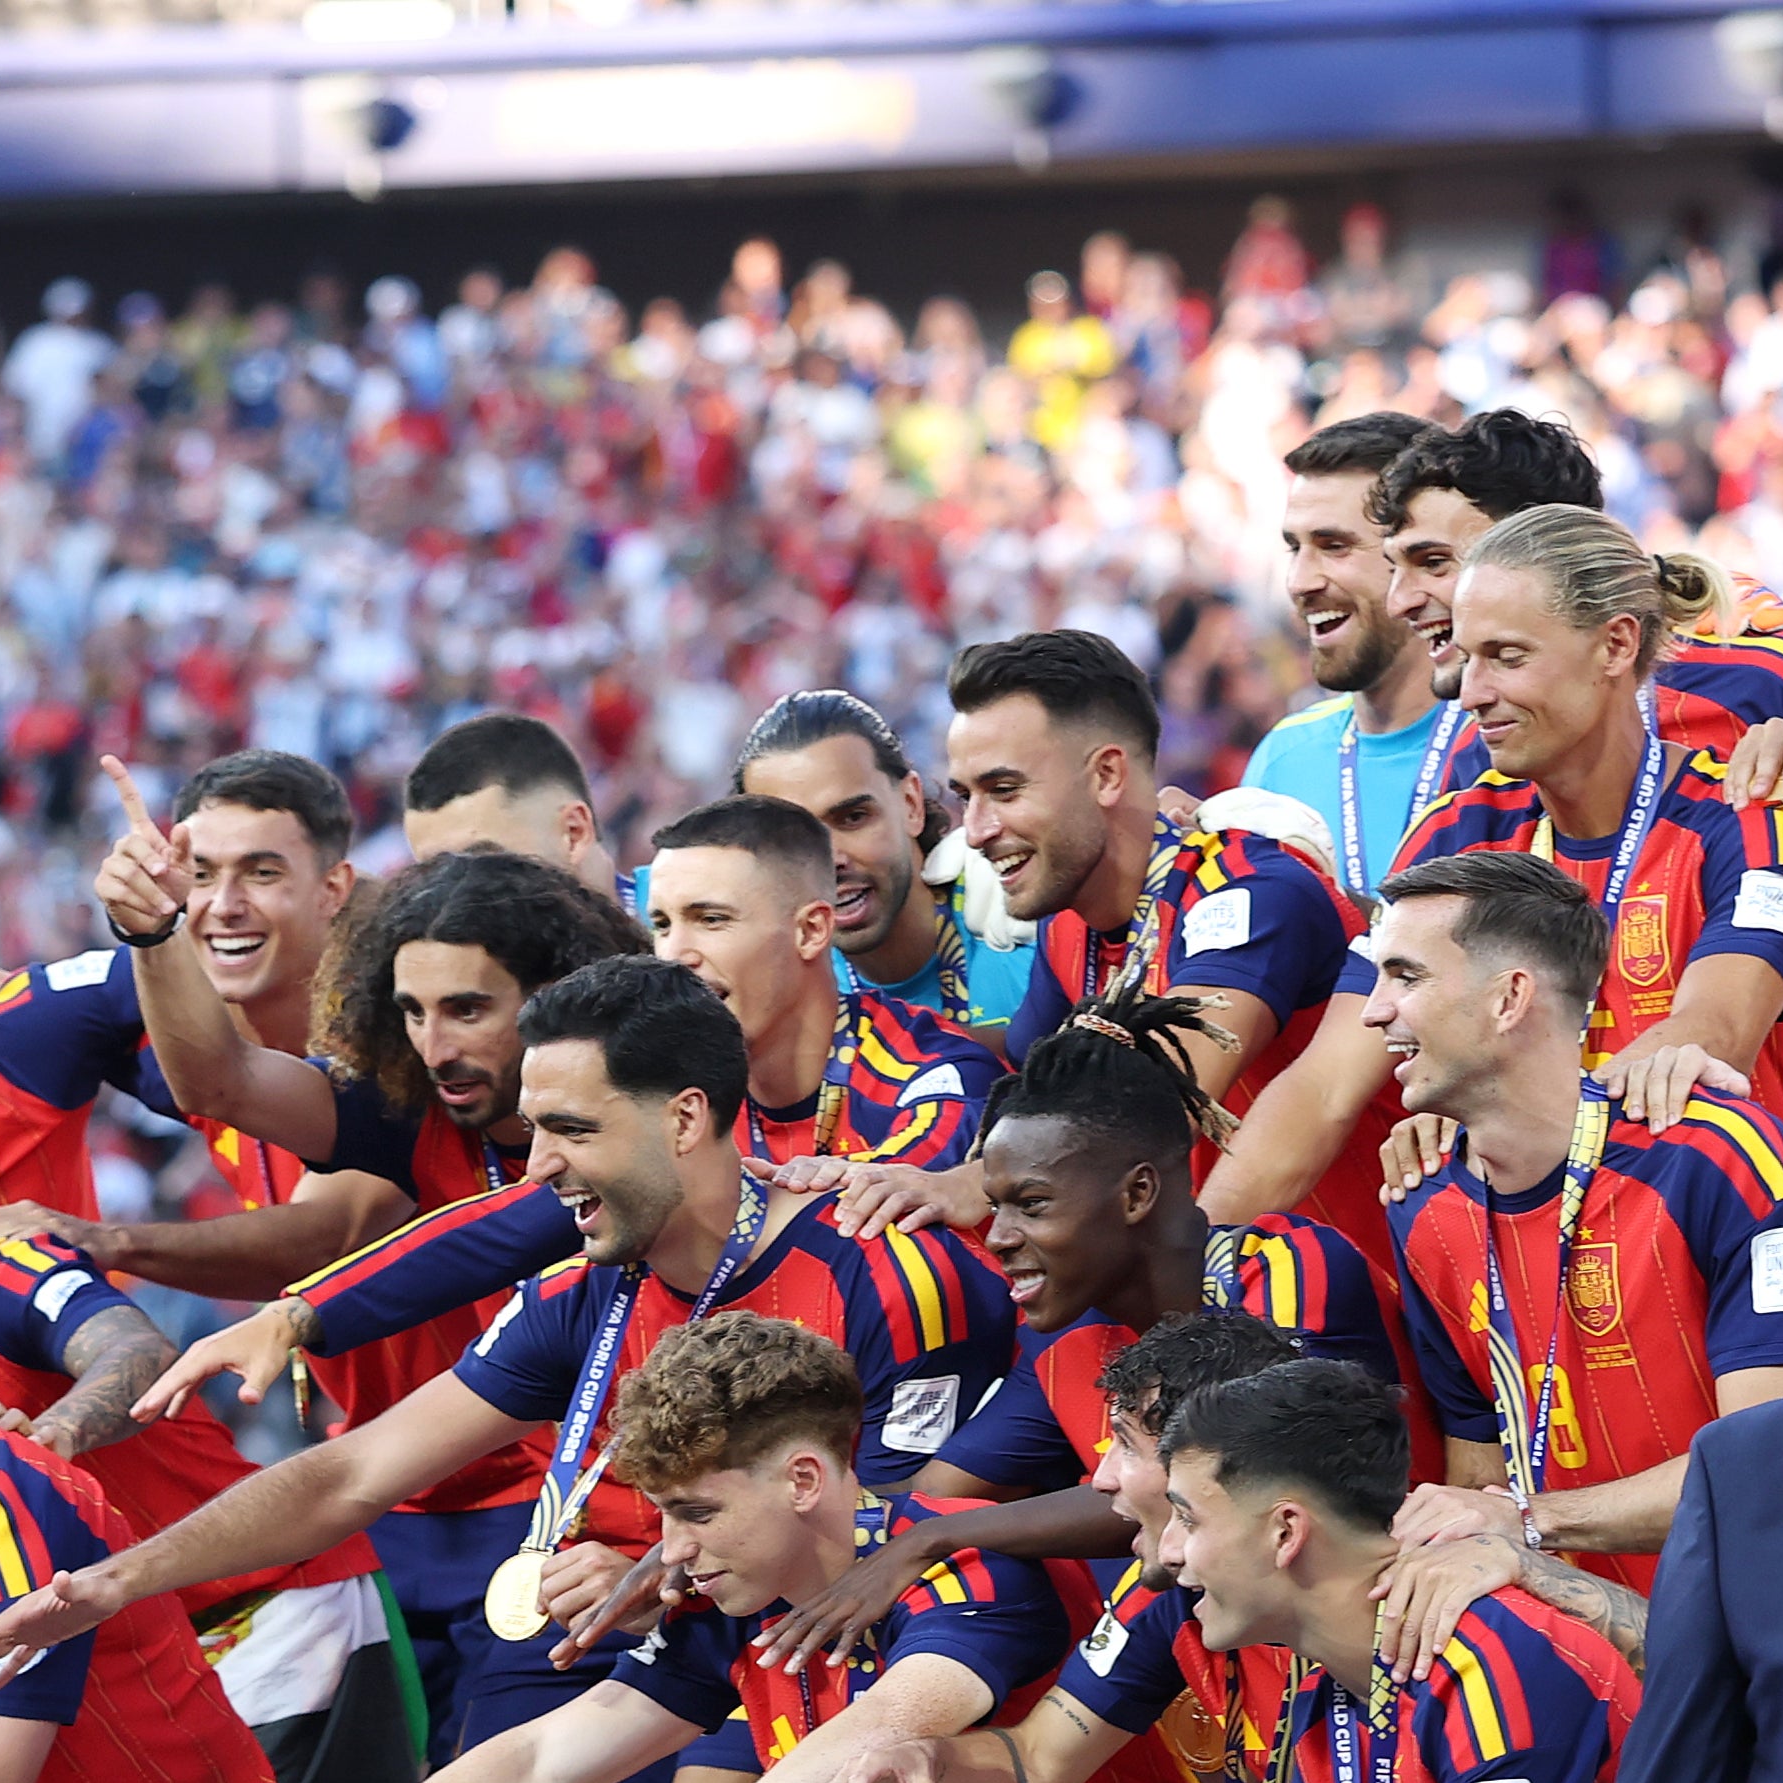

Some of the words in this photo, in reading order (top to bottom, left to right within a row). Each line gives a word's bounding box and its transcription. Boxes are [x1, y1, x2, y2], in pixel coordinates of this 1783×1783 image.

[1341, 768, 1355, 801] FIFA
[1420, 751, 1442, 785] CUP
[1343, 803, 1359, 857] WORLD
[1606, 870, 1628, 903] FIFA
[1617, 809, 1648, 870] WORLD
[1635, 773, 1658, 808] CUP
[1346, 858, 1364, 892] CUP
[710, 1257, 737, 1291] FIFA
[607, 1292, 630, 1325] FIFA
[588, 1325, 619, 1380] WORLD
[577, 1382, 600, 1413] CUP
[1536, 1369, 1554, 1430] WORLD
[559, 1410, 590, 1463] 2026
[1531, 1430, 1546, 1467] FIFA
[1335, 1733, 1353, 1765] CUP
